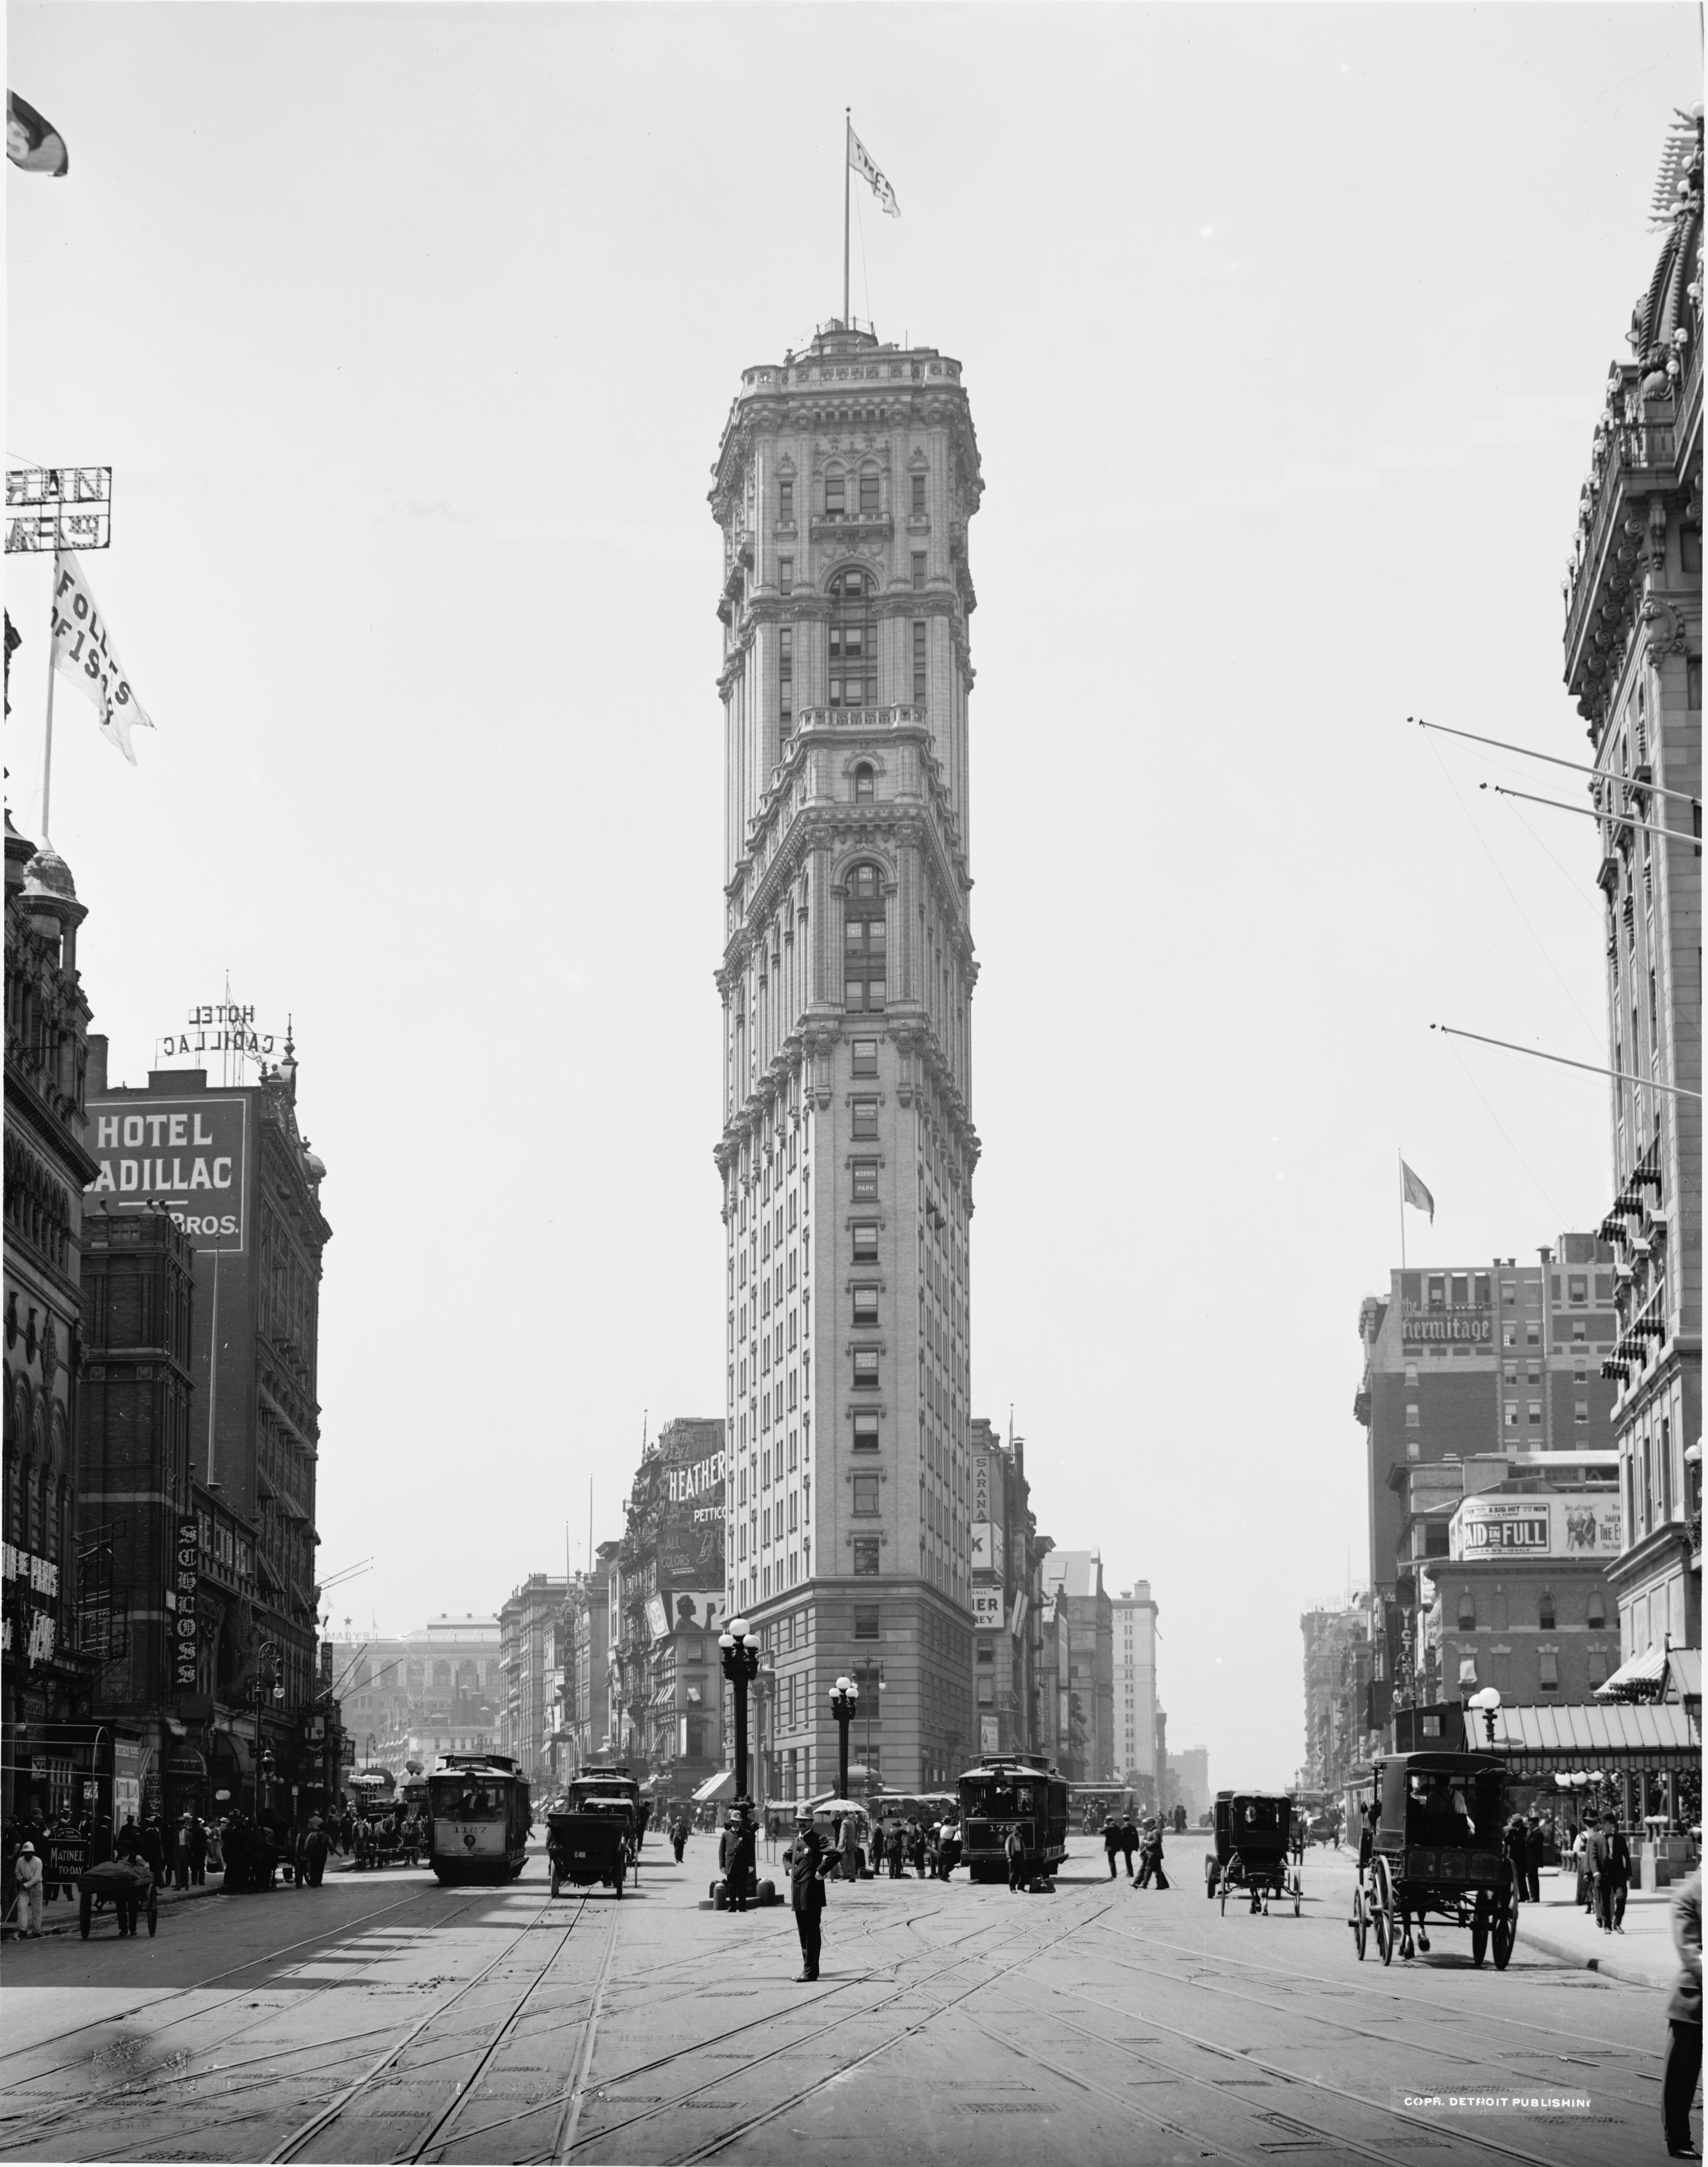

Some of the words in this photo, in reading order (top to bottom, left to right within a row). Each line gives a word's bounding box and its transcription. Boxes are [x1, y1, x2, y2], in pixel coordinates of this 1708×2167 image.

[97, 1113, 213, 1148] HOTEL
[83, 1157, 232, 1192] ADILLAC
[169, 1213, 239, 1235] BROS.
[1402, 1317, 1489, 1342] hermitage
[669, 1450, 725, 1502] HEATHER
[976, 1458, 987, 1519] SARANA
[1502, 1522, 1545, 1545] FULL
[1598, 1524, 1613, 1540] THE
[665, 1536, 681, 1551] ALL
[662, 1554, 690, 1568] COLORS
[327, 1631, 370, 1640] MACY'S
[565, 1611, 574, 1718] BROADWAY
[50, 1847, 84, 1868] MATINEE
[59, 1866, 83, 1875] TO-DAY
